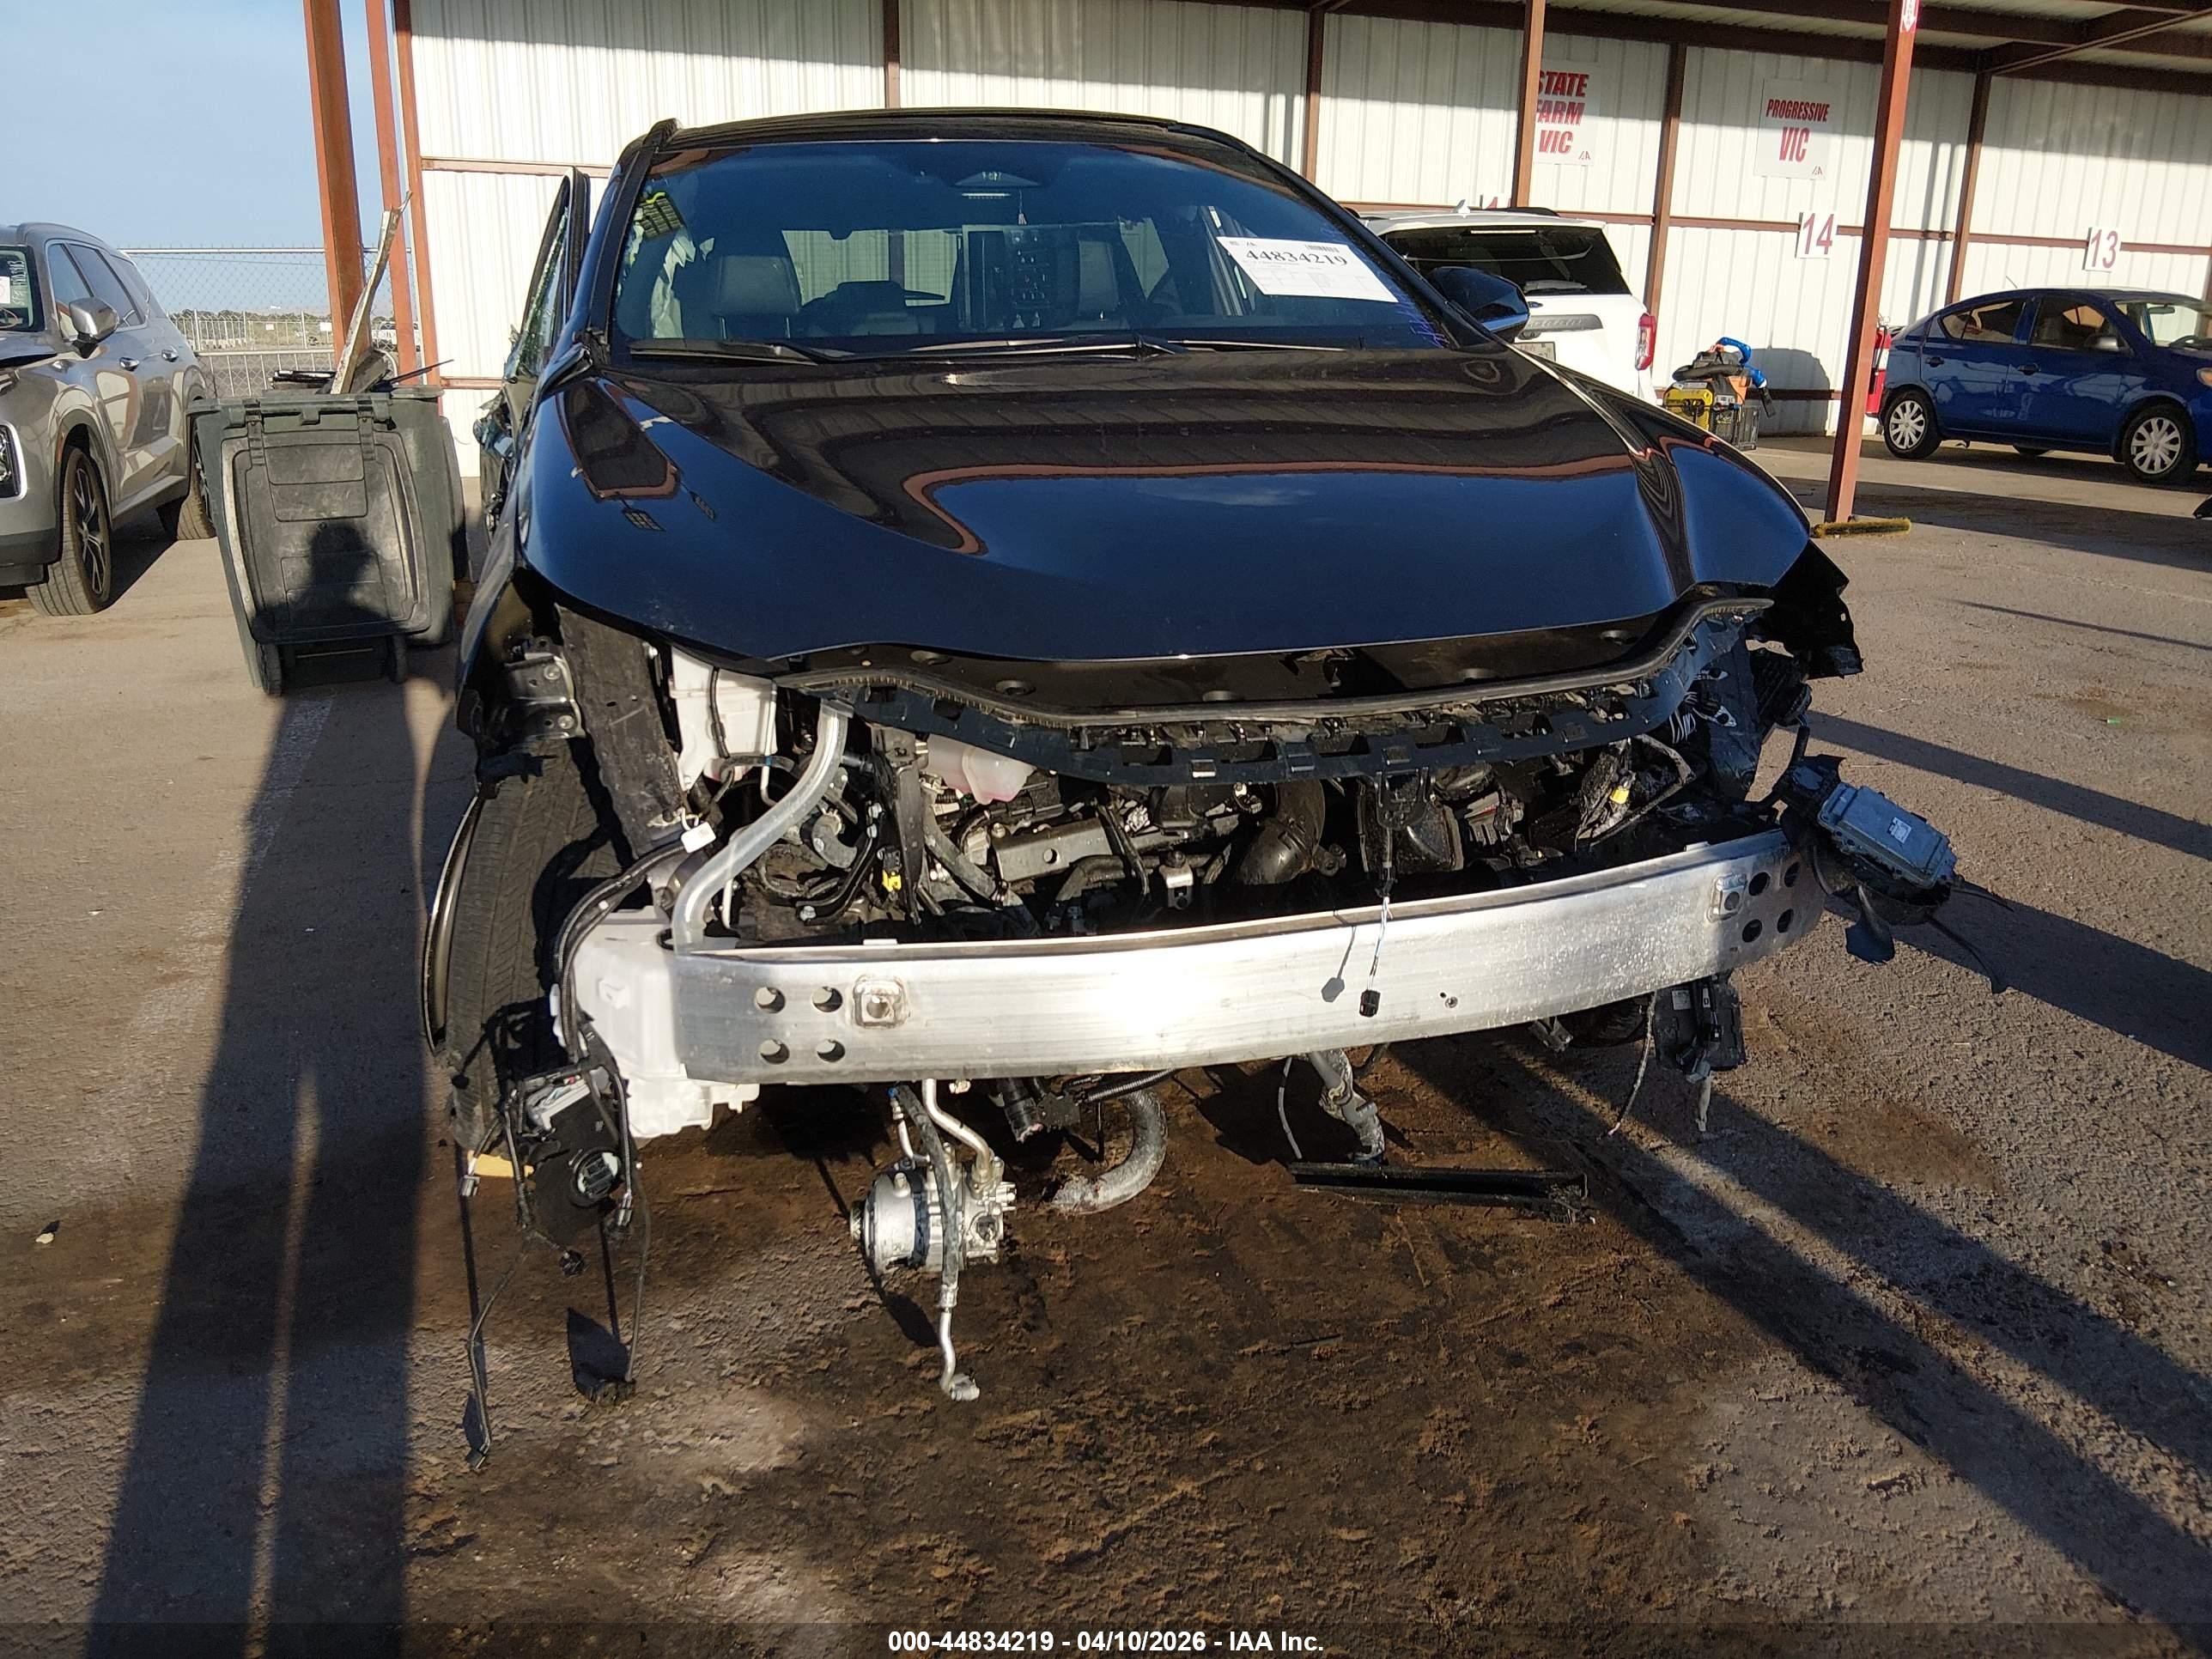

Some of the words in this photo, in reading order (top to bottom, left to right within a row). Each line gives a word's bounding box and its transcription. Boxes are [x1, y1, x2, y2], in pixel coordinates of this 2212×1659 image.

[1536, 100, 1585, 126] ARM
[1765, 99, 1830, 122] PROGRESSIVE
[1539, 129, 1573, 155] VIC
[1779, 126, 1810, 162] VIC
[1803, 212, 1834, 255] 14
[1246, 250, 1347, 266] 44834219
[2090, 228, 2118, 269] 13
